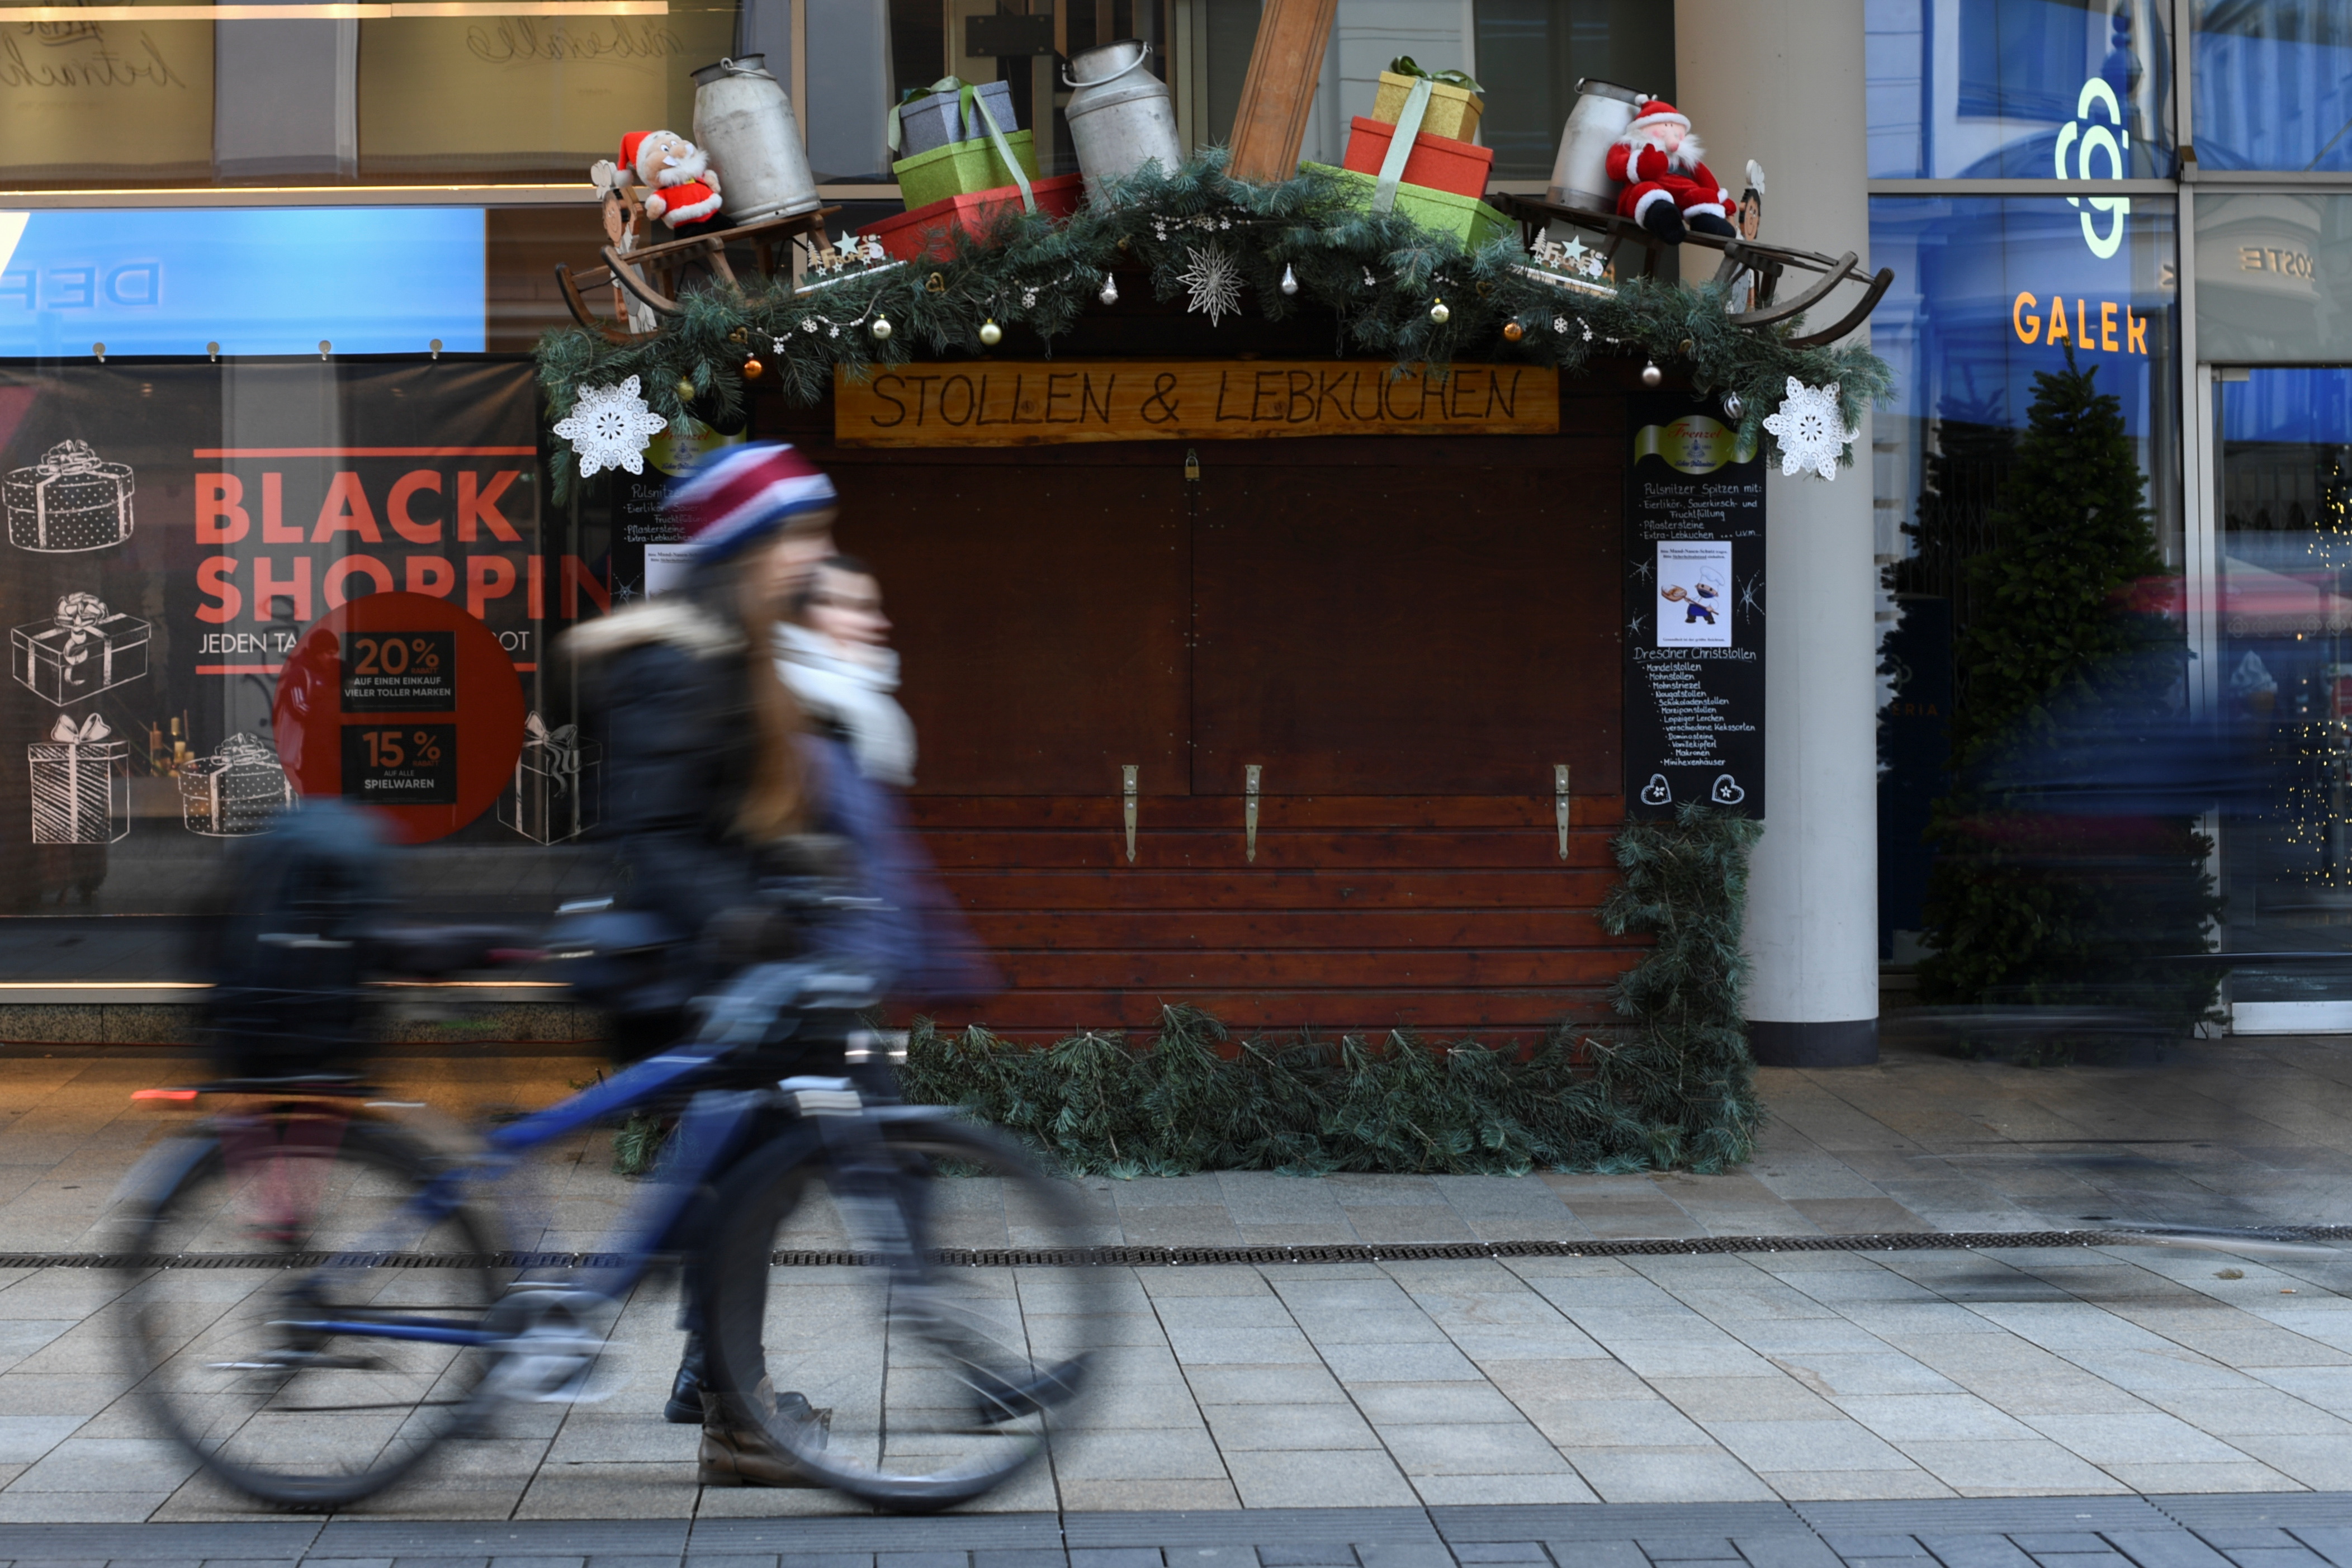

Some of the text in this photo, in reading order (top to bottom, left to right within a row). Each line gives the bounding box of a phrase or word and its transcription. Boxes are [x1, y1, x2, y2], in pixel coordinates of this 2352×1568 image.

[870, 368, 1522, 428] STOLLEN & LEBKUCHEN
[1668, 423, 1722, 438] Frenzel
[1644, 482, 1762, 498] Pulsnitzer Spitzen mit:
[195, 470, 523, 544] BLACK
[1743, 499, 1758, 508] und
[1669, 509, 1725, 522] Fruchtfüllung
[627, 524, 686, 535] Pflastersteine
[1643, 519, 1705, 530] Pflastersteine
[199, 633, 268, 655] JEDEN
[1633, 646, 1757, 660] Dresdner Christstollen
[1646, 662, 1702, 671] Mandelstollen
[354, 677, 372, 685] AUF
[403, 676, 442, 685] EINKAUF
[1649, 671, 1695, 681] Mohnstollen
[1653, 680, 1701, 690] Mohnstriezel
[344, 688, 451, 697] VIELER TOLLER MARKEN
[1655, 690, 1707, 699] Nougatstollen
[1658, 697, 1730, 707] Schokoladenstollen
[1661, 706, 1717, 715] Marzipanstollen
[1664, 714, 1724, 725] Leipziger Lerchen
[1665, 722, 1755, 732] verschiedene Kekssorten
[1668, 732, 1714, 741] Dominosteine
[1672, 739, 1717, 750] Vanillekipferl
[1663, 757, 1726, 766] Minihexenhäuser
[364, 779, 434, 789] SPIELWAREN
